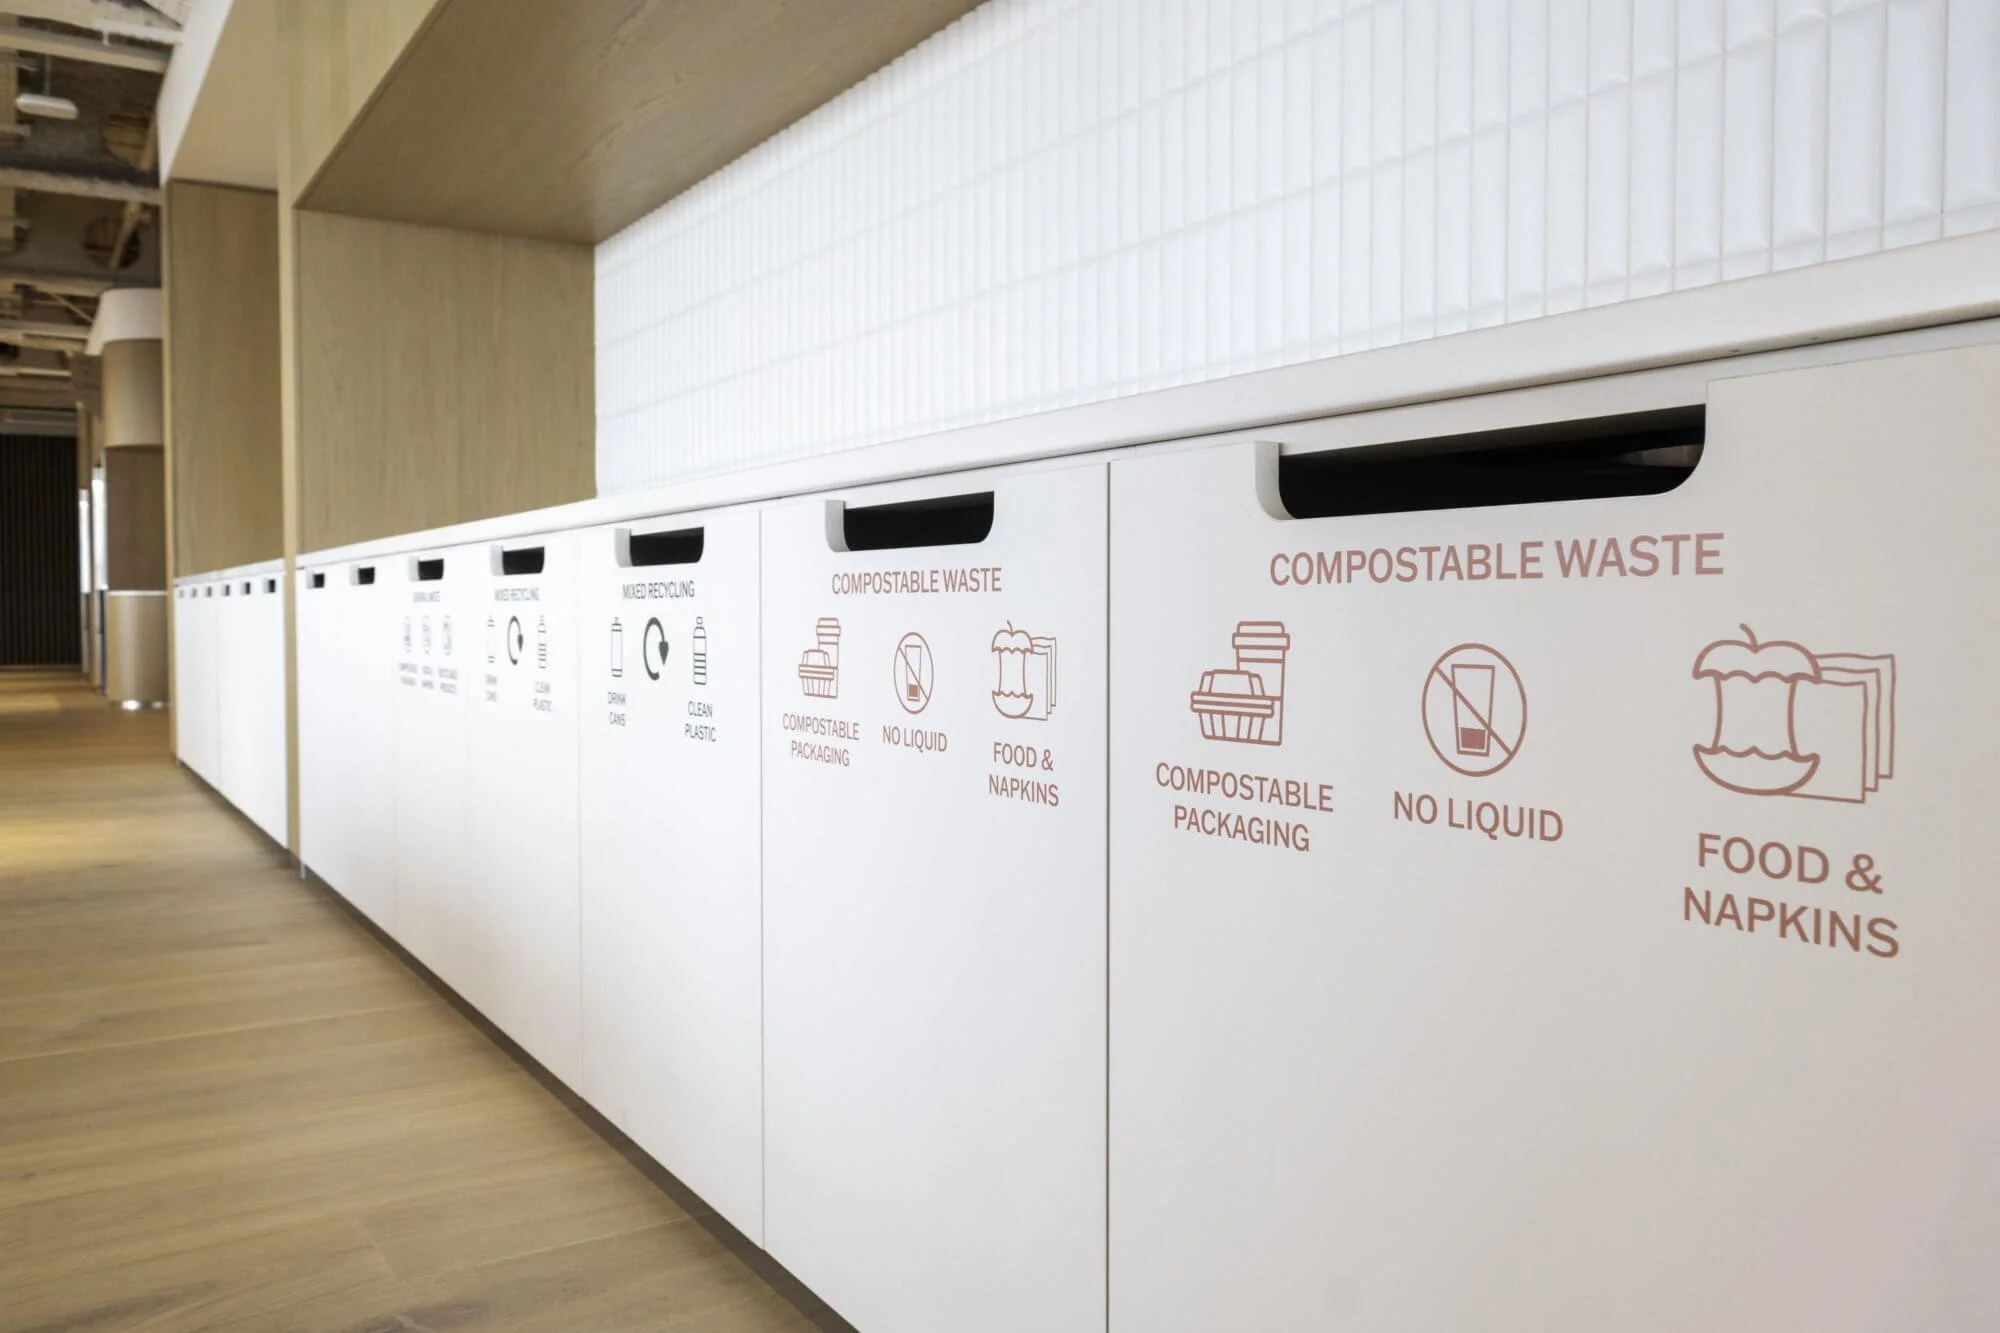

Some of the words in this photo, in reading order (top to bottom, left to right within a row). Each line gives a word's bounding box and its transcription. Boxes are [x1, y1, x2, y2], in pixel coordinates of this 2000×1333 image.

[1270, 541, 1543, 586] COMPOSTABLE
[1555, 533, 1725, 578] WASTE
[648, 580, 695, 599] RECYCLING
[832, 569, 940, 595] COMPOSTABLE
[943, 567, 1002, 593] WASTE
[688, 701, 713, 718] CLEAN
[684, 723, 717, 743] PLASTIC
[783, 713, 860, 741] COMPOSTABLE
[882, 725, 901, 746] NO
[903, 728, 948, 753] LIQUID
[791, 740, 850, 768] PACKAGING
[993, 742, 1037, 769] FOOD
[1041, 749, 1054, 771] &
[989, 774, 1060, 808] NAPKINS
[1156, 762, 1334, 813] COMPOSTABLE
[1174, 804, 1310, 852] PACKAGING
[1393, 791, 1438, 825] NO
[1447, 797, 1563, 843] LIQUID
[1698, 833, 1830, 885] FOOD
[1844, 853, 1884, 895] &
[1684, 886, 1900, 959] NAPKINS
